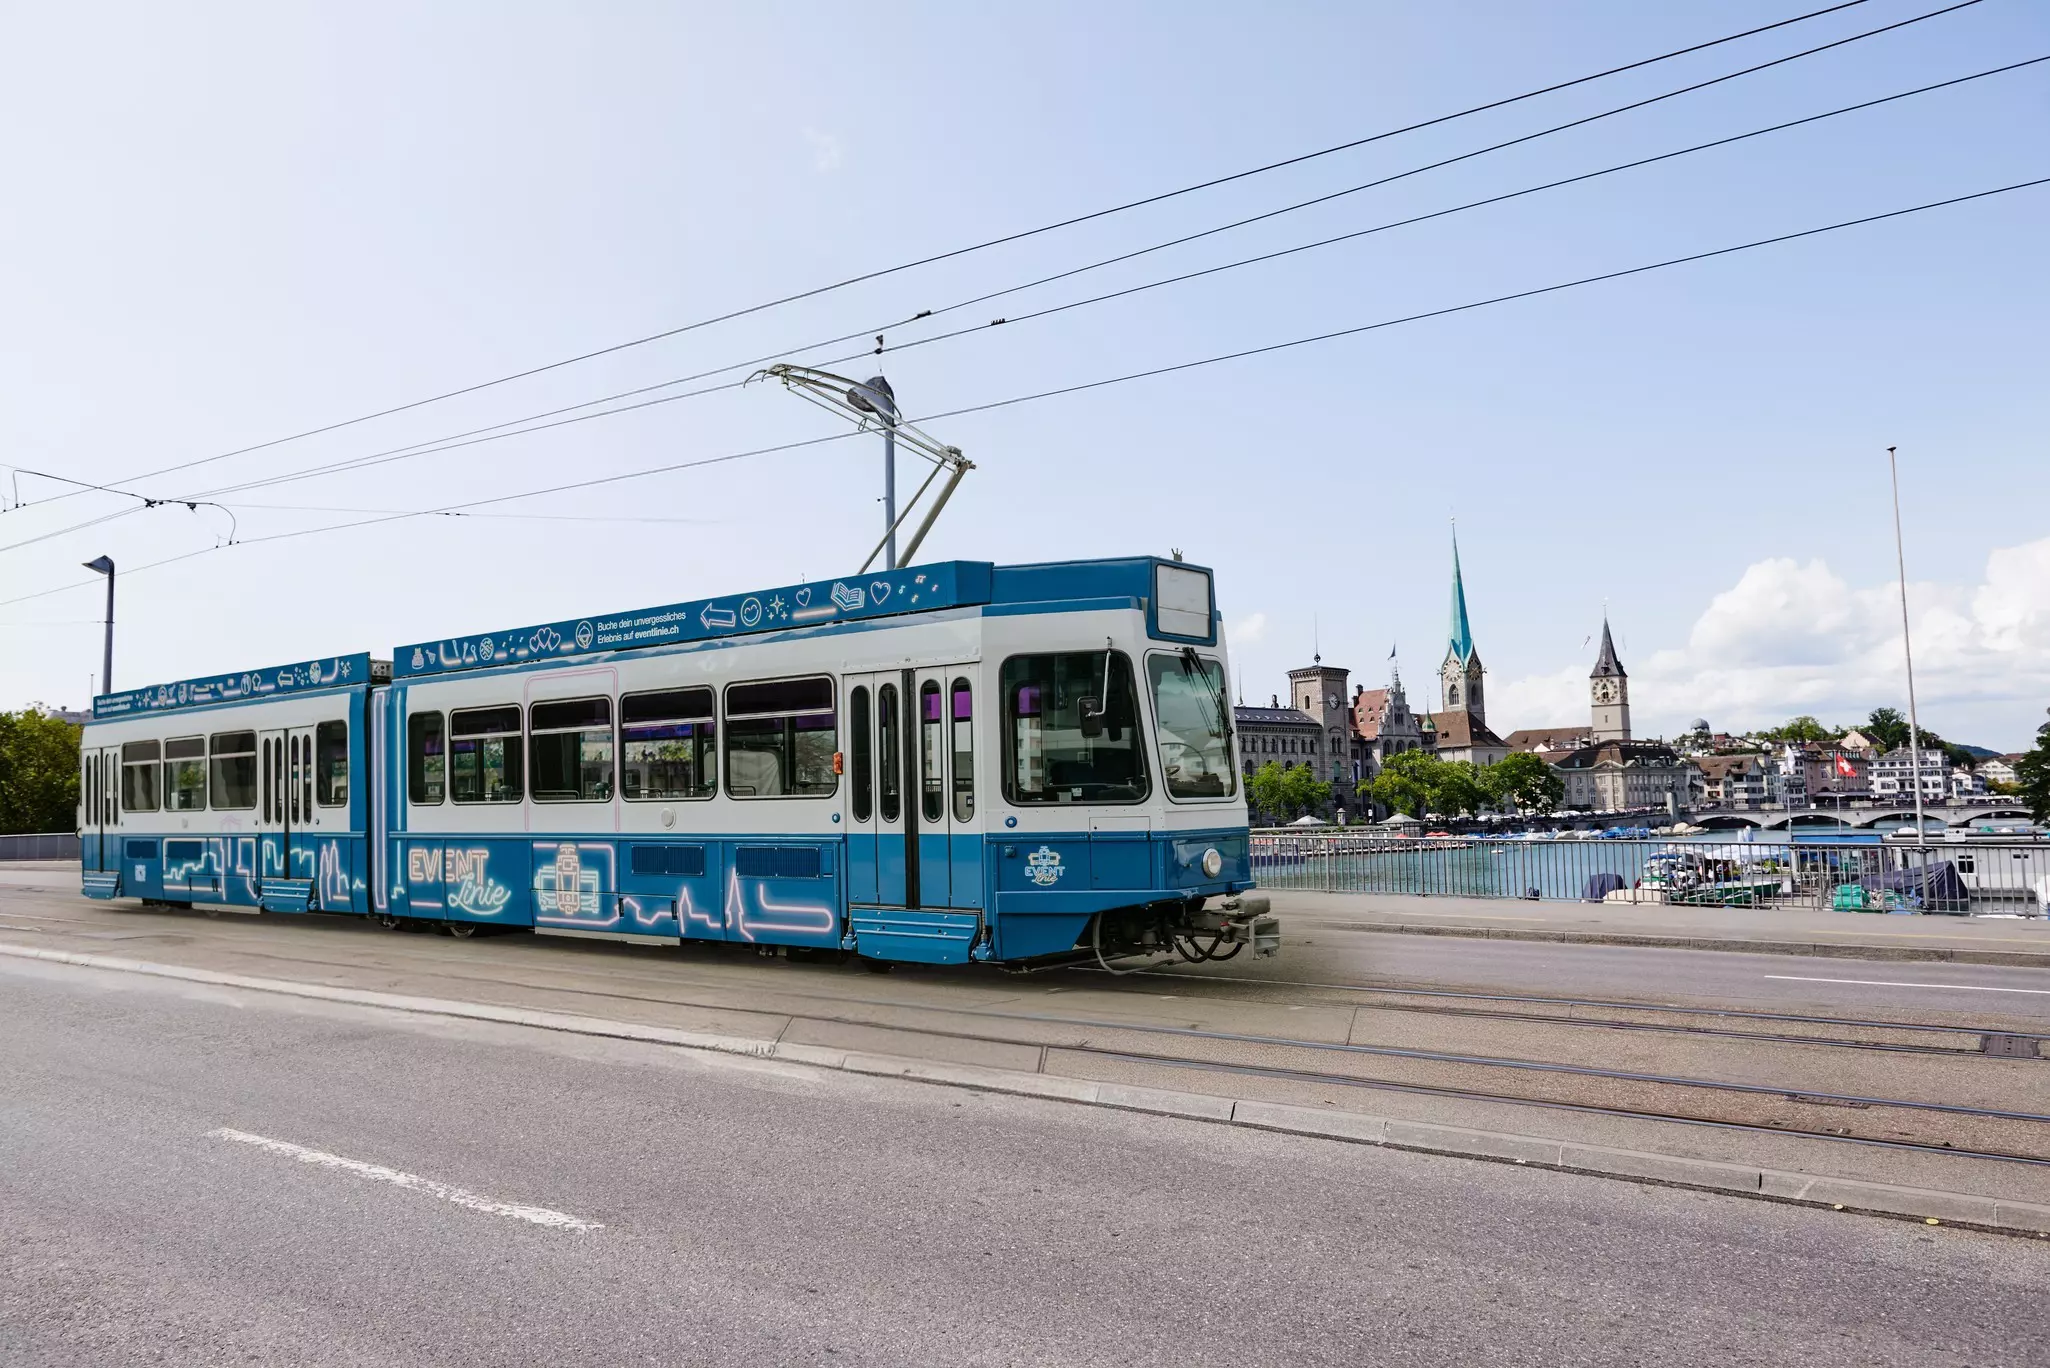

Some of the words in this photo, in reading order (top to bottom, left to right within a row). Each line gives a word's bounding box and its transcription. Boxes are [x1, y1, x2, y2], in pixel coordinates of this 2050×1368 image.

[597, 621, 617, 631] Buche
[618, 618, 632, 628] dein
[633, 612, 686, 625] unvergessliches
[597, 632, 622, 643] Erlebnis
[623, 630, 634, 640] auf
[634, 625, 679, 638] eventlinie.ch
[408, 848, 489, 885] EVENT
[1024, 866, 1065, 876] EVENT
[447, 872, 512, 915] Linie
